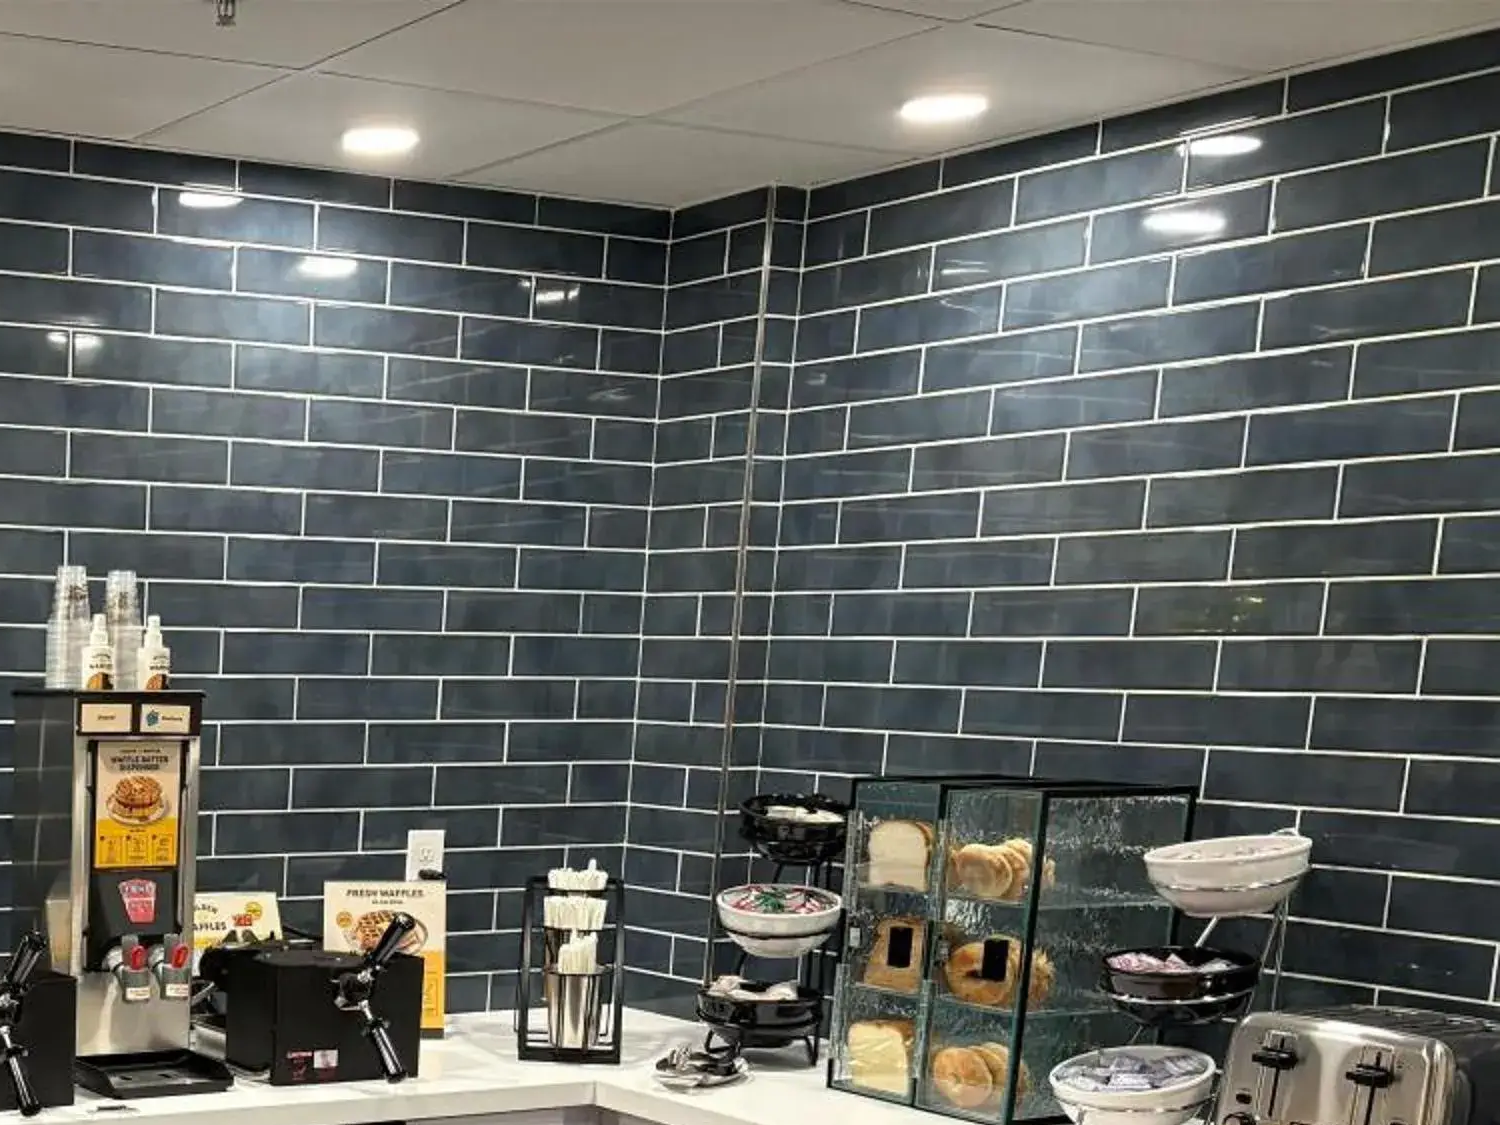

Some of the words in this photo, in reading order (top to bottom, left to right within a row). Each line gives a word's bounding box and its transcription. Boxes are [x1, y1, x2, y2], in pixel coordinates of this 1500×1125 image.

[346, 889, 378, 898] FRESH
[380, 888, 424, 898] WAFFLES
[192, 921, 227, 931] AFFLES
